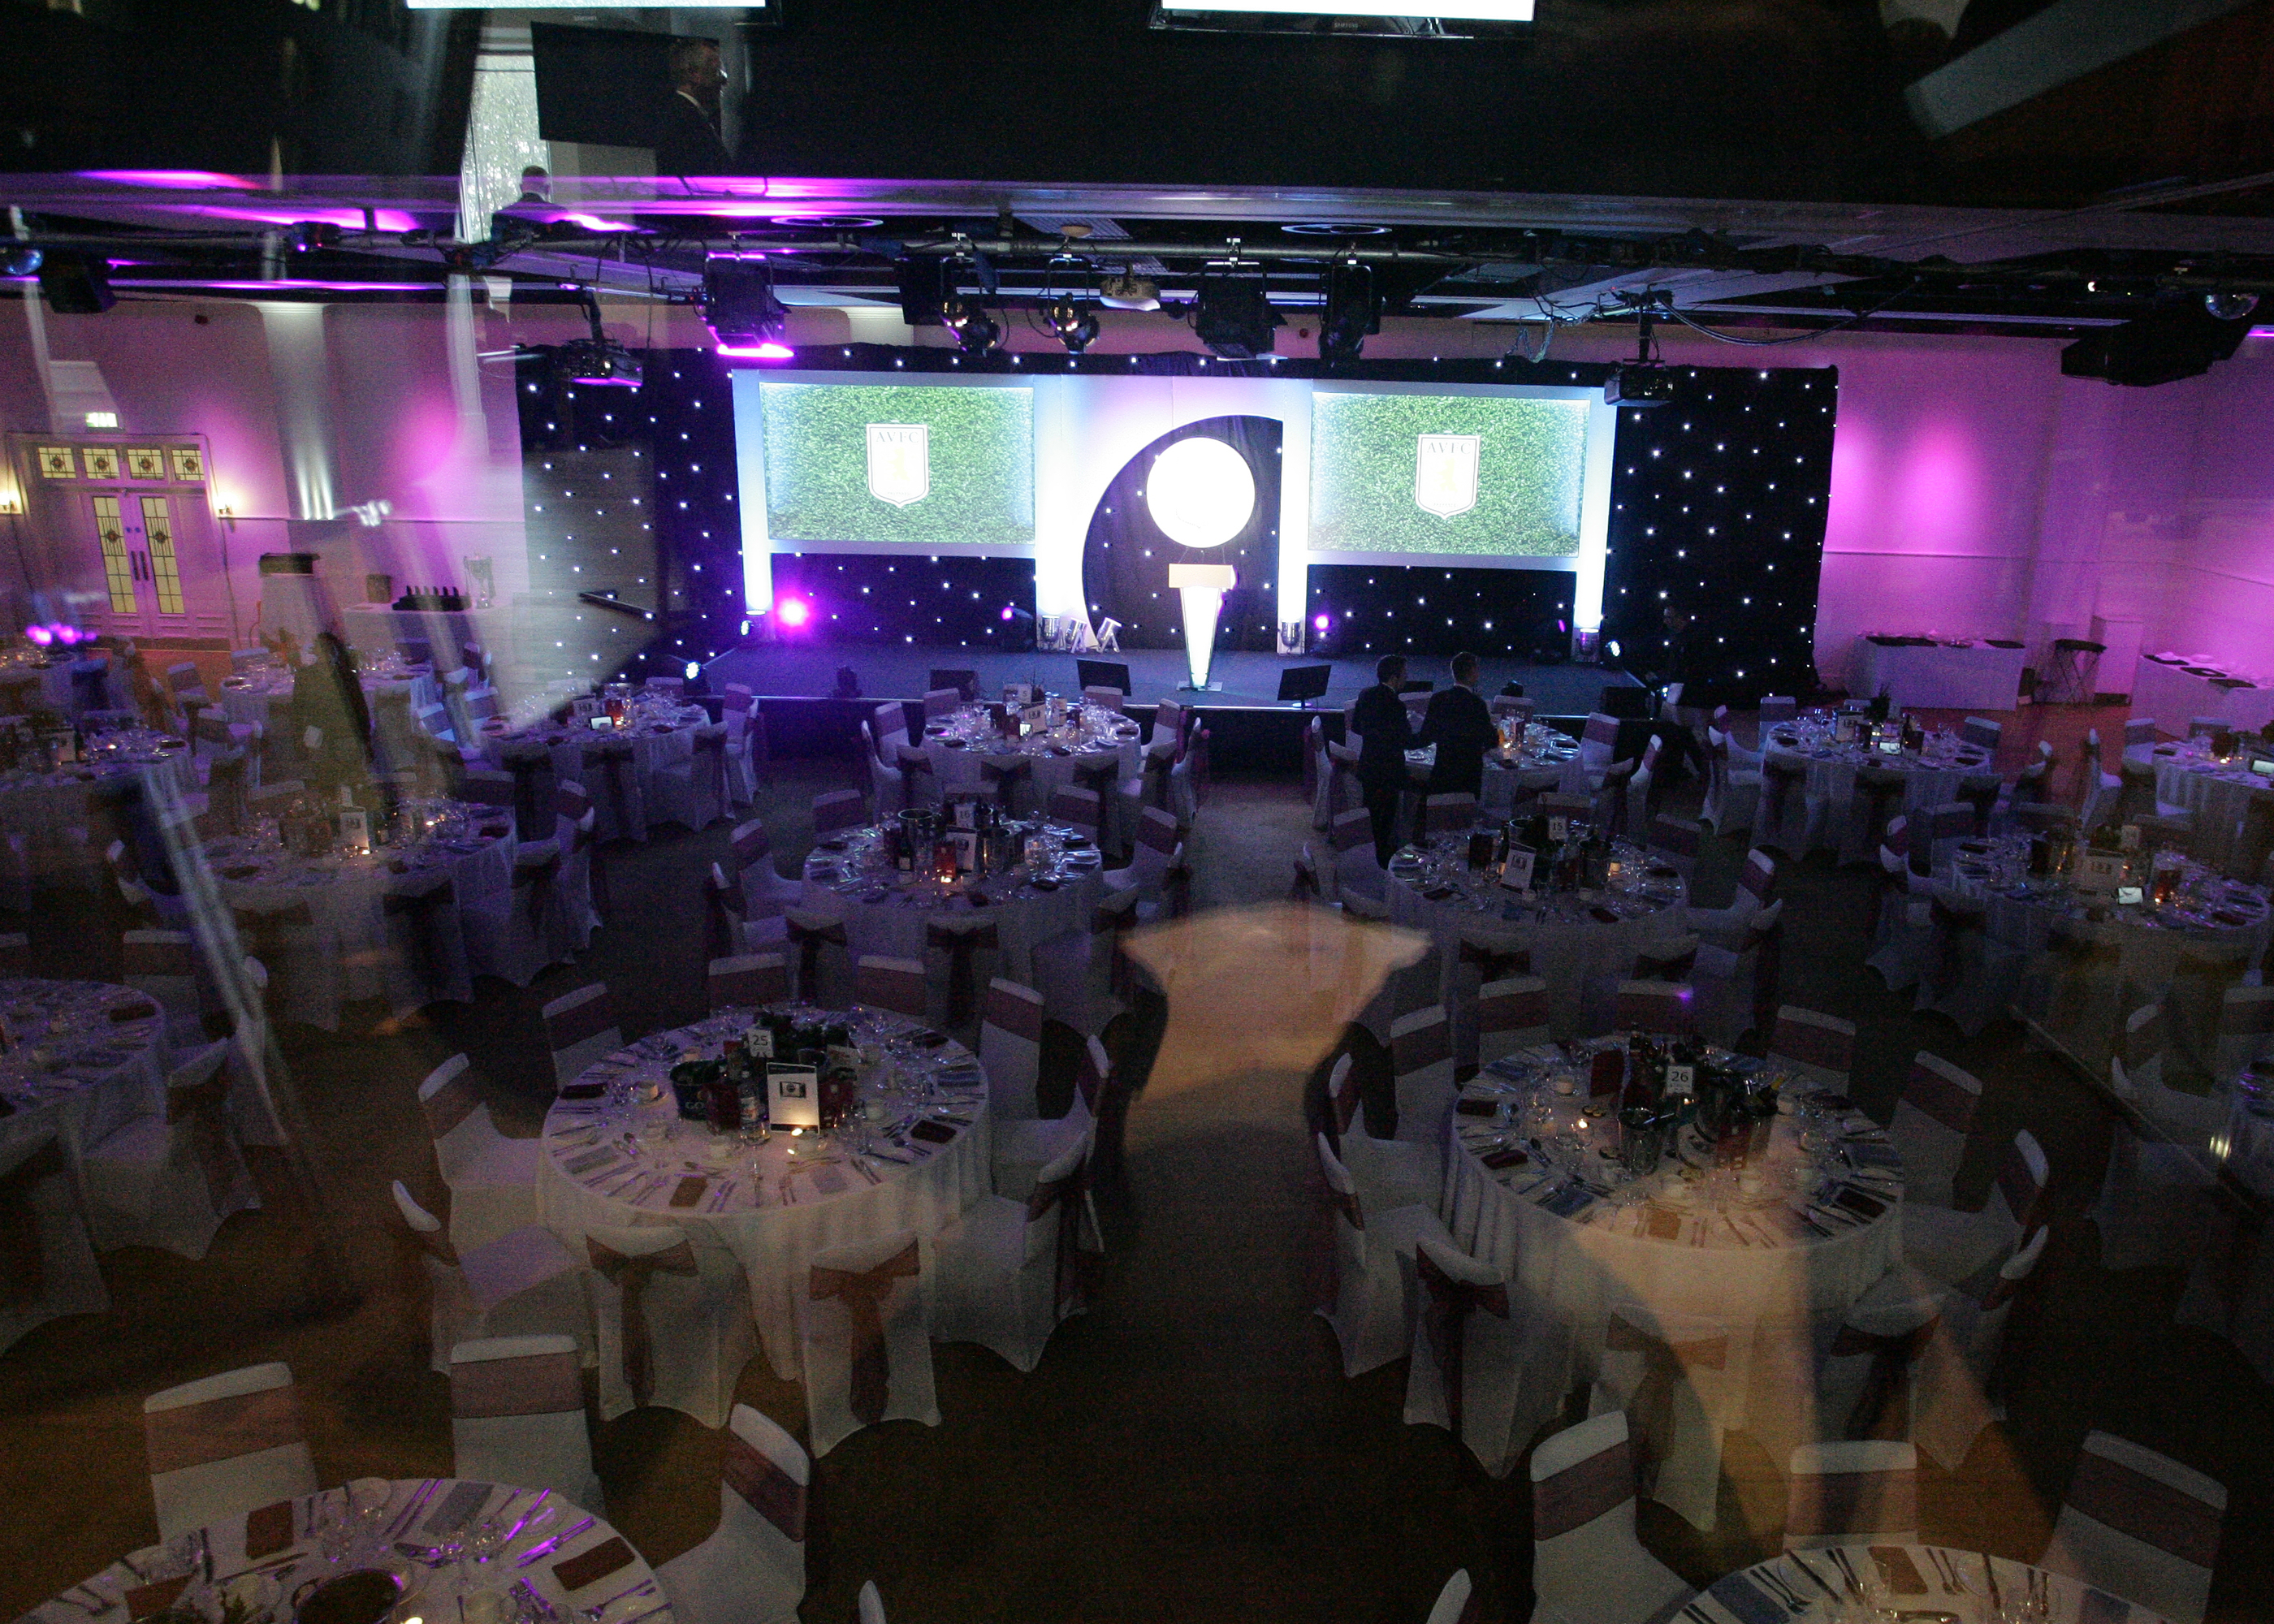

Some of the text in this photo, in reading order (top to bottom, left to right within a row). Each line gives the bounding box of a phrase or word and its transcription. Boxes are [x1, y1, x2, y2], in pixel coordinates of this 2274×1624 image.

[876, 431, 919, 443] AVFC
[1427, 442, 1471, 454] AVFC
[959, 810, 971, 819] 16
[1553, 823, 1563, 831] 15
[752, 1034, 768, 1046] 25
[1671, 1071, 1688, 1082] 26
